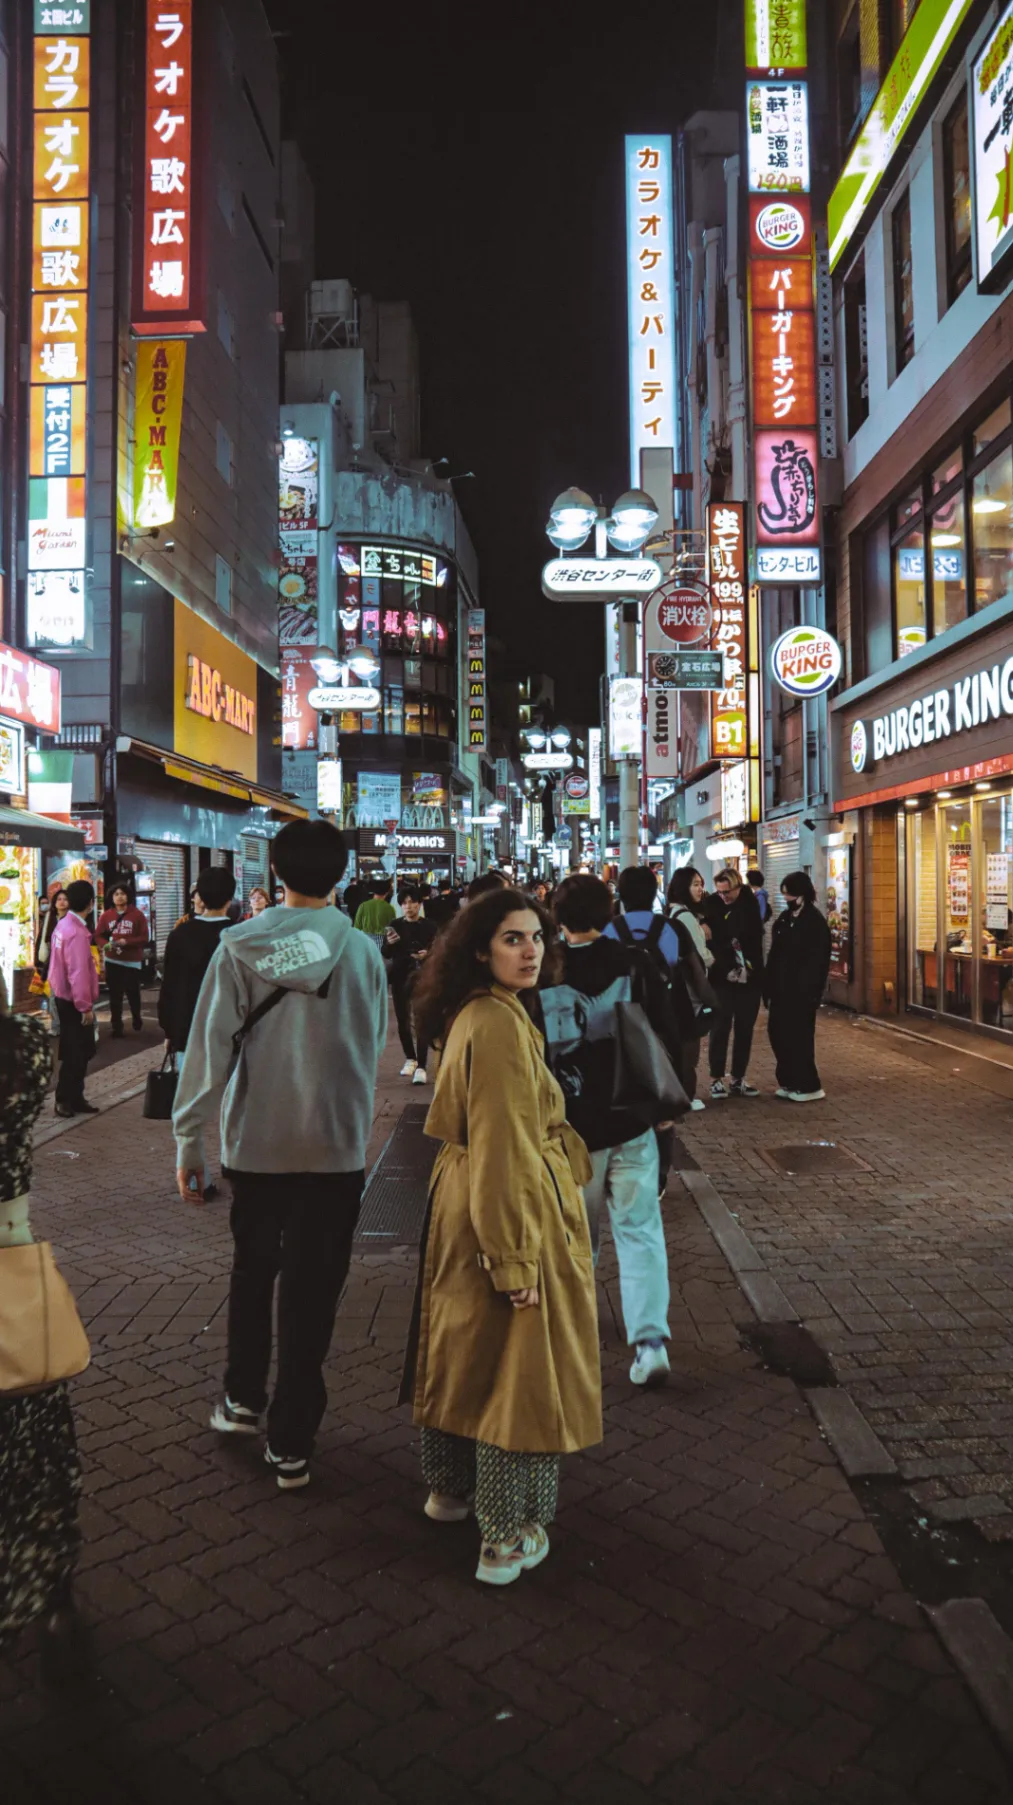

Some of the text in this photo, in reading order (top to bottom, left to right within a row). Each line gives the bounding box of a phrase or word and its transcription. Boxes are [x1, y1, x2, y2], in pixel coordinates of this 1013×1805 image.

[770, 0, 793, 58] 貴族
[768, 68, 785, 76] 4F
[44, 40, 79, 192] カラオケ
[762, 212, 797, 230] BURGER
[764, 220, 799, 241] KING
[40, 251, 80, 380] 歌広場
[769, 268, 797, 419] バーガーキング
[713, 508, 741, 579] 生ビール
[551, 568, 656, 582] 渋谷センター街
[758, 555, 819, 573] センタービル
[662, 604, 708, 626] 消火栓
[780, 641, 830, 662] BURGER
[782, 653, 832, 679] KING
[190, 655, 255, 735] ABC-MART
[281, 664, 302, 744] 青龍門
[873, 656, 1013, 761] BURGER KING
[716, 720, 743, 743] B1
[375, 834, 445, 848] MDonald's
[270, 934, 300, 951] THE
[256, 945, 305, 971] NORTH
[273, 954, 308, 978] FACE
